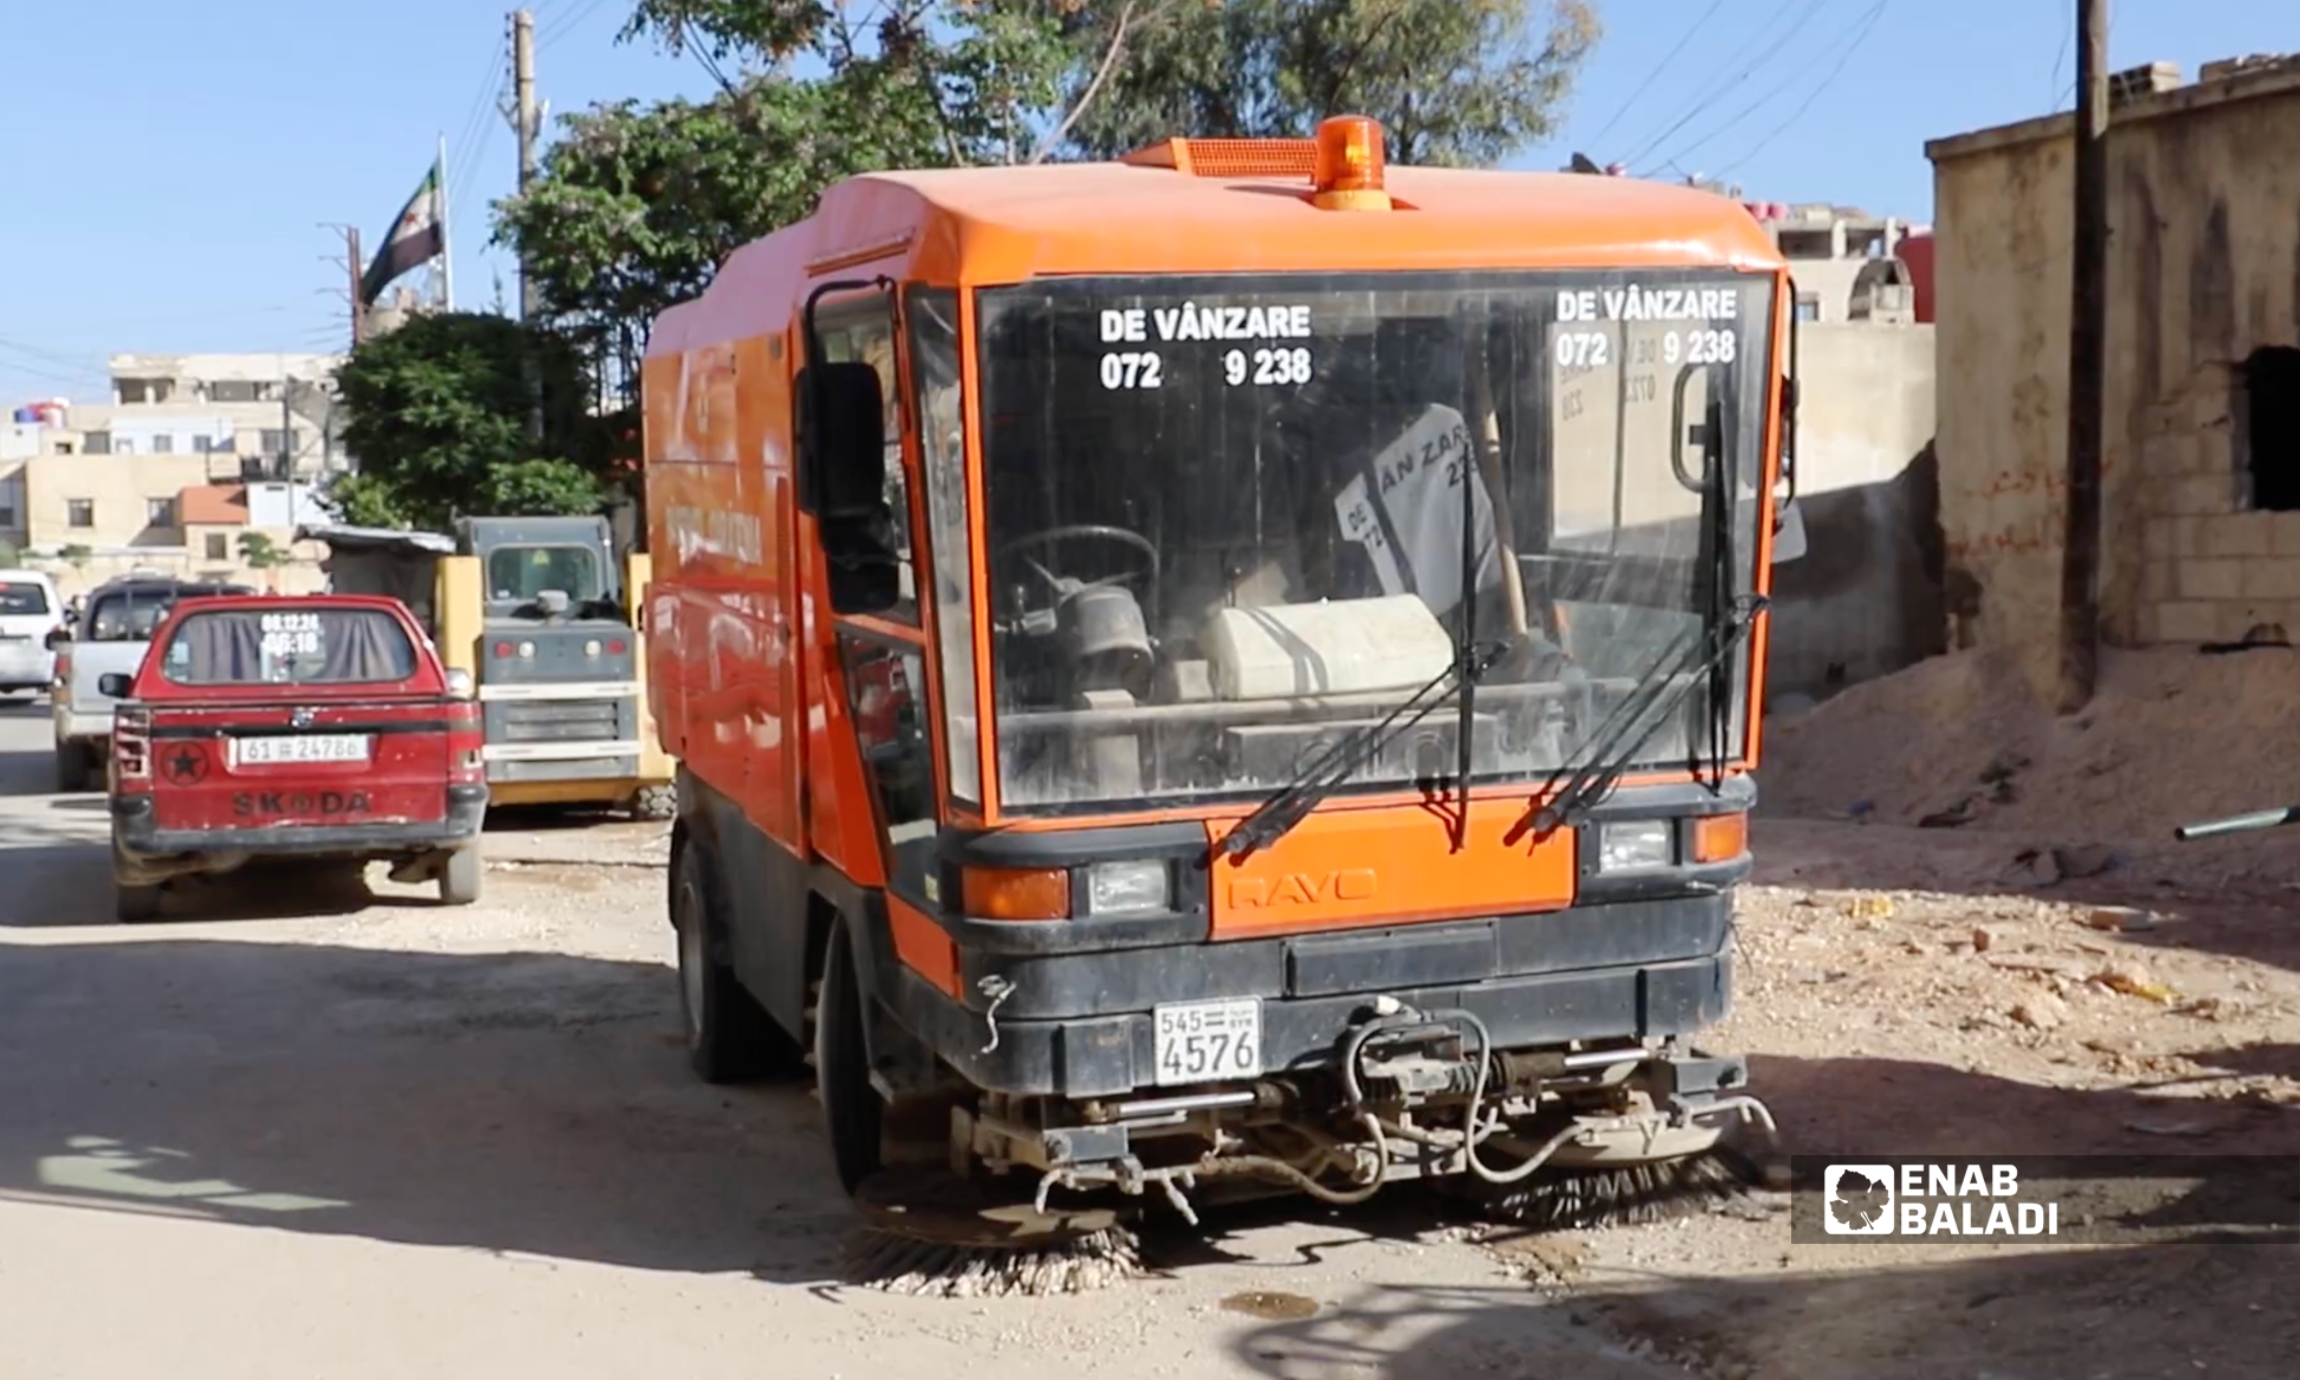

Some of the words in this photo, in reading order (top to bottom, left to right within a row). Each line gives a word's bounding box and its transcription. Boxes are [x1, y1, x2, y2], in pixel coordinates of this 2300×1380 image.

[1100, 309, 1146, 342] DE
[1153, 301, 1311, 341] VÂNZARE
[1556, 291, 1596, 321] DE
[1603, 284, 1737, 320] VÂNZARE
[1557, 332, 1607, 365] 072
[1664, 331, 1680, 364] 9
[1688, 329, 1736, 363] 238
[1100, 352, 1161, 389] 072
[1225, 349, 1247, 386] 9
[1253, 348, 1311, 384] 238
[248, 741, 271, 760] 61
[1228, 868, 1377, 910] RAVO
[1162, 1011, 1201, 1034] 545
[1163, 1031, 1254, 1077] 4576
